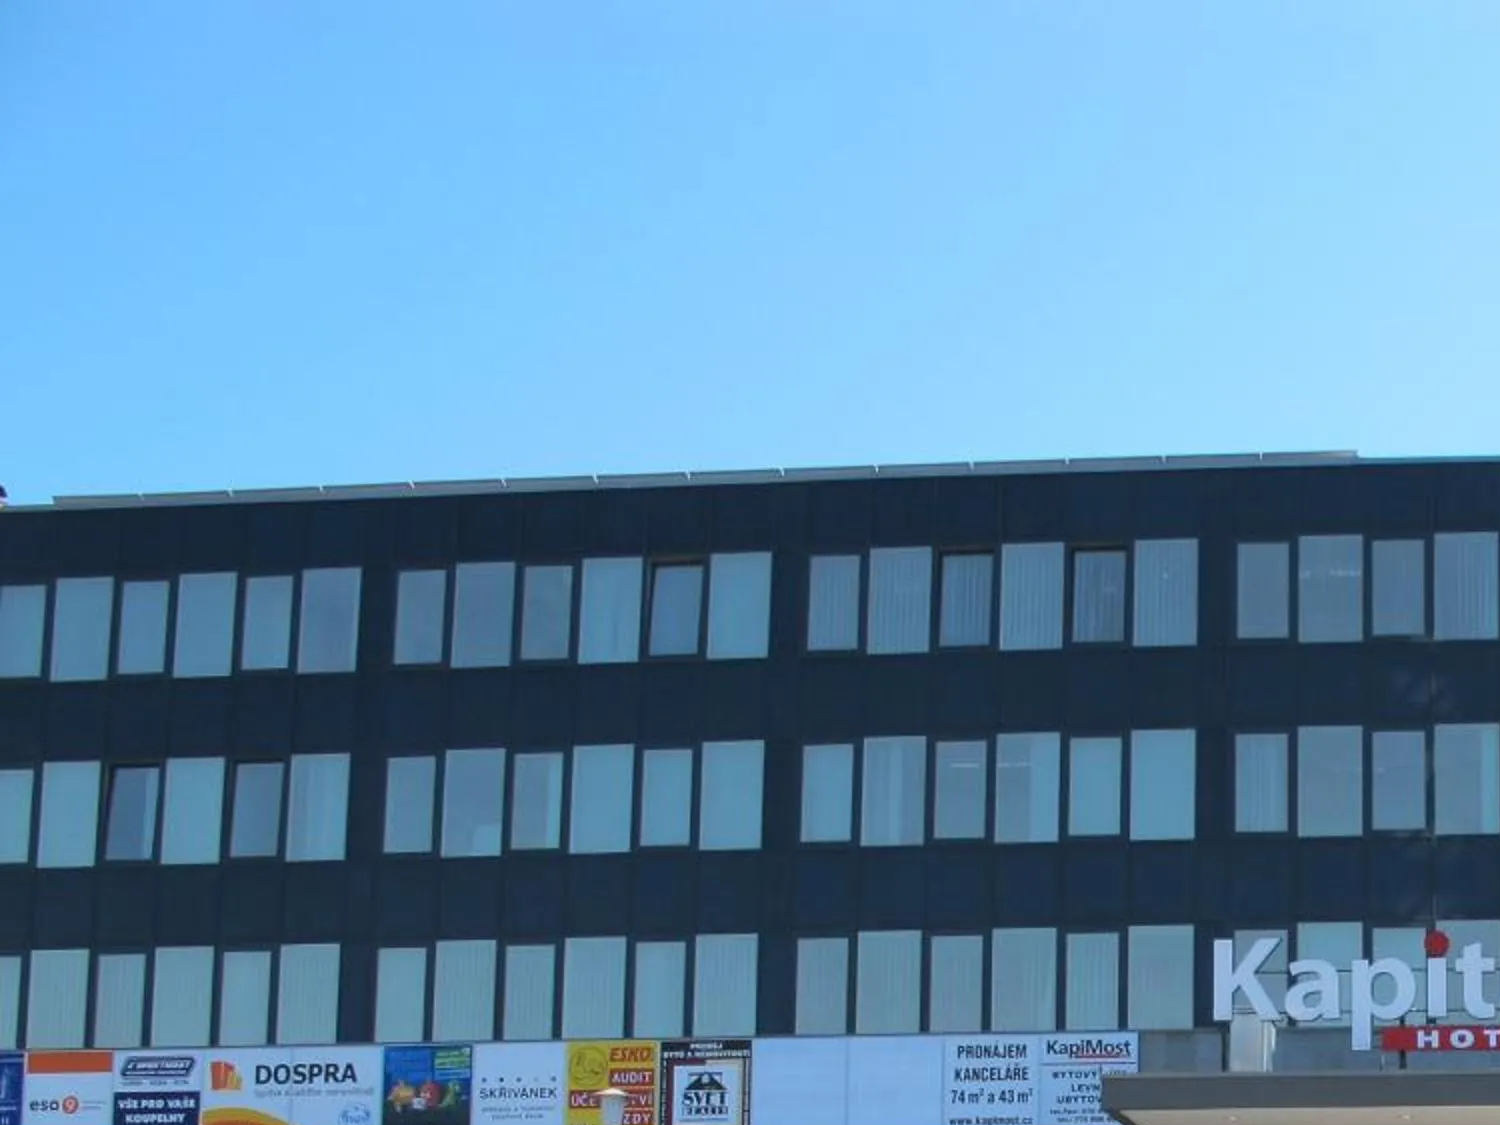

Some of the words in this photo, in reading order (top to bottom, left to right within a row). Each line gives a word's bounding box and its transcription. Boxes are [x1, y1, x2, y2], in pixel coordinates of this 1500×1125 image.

[1046, 1039, 1131, 1058] KapiMost
[255, 1063, 357, 1085] DOSPRA
[612, 1071, 652, 1085] AUDIT
[951, 1090, 966, 1104] 74
[987, 1093, 995, 1104] a
[998, 1090, 1015, 1104] 43
[622, 1113, 651, 1125] ZDY
